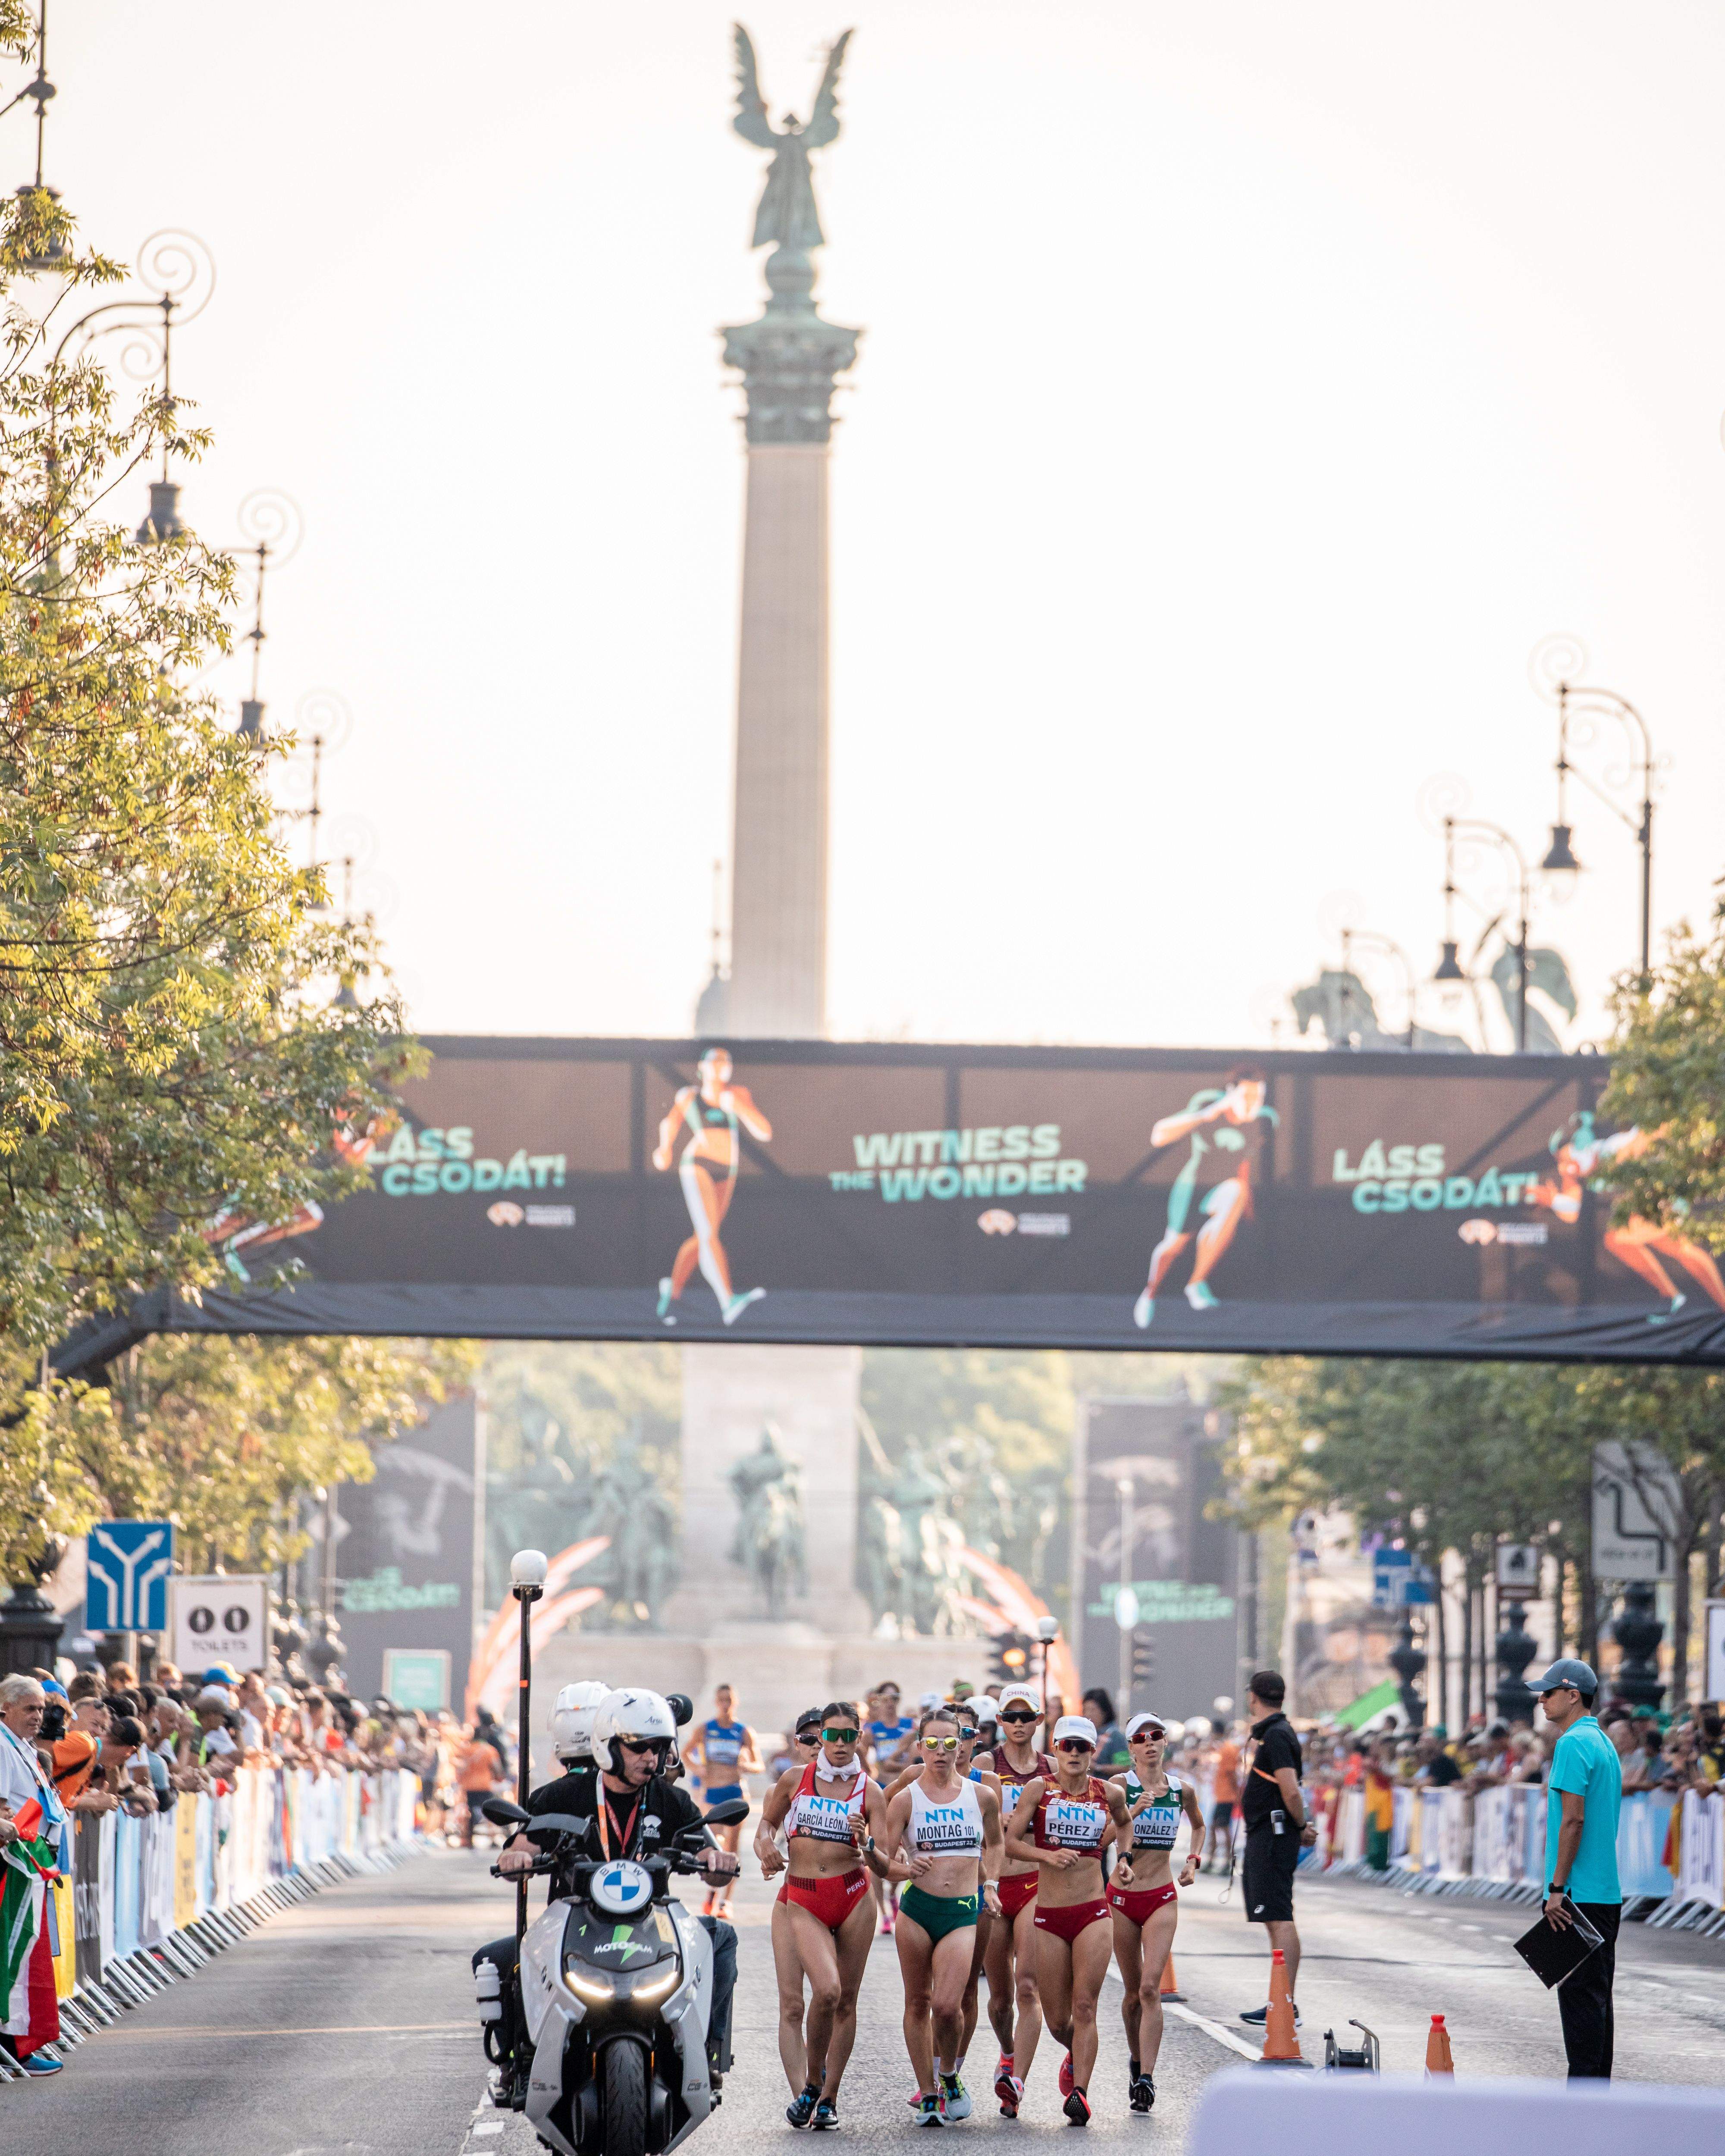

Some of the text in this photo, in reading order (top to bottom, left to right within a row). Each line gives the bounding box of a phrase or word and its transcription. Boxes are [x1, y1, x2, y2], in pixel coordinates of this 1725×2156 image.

[853, 1124, 1061, 1168] WITNESS
[1333, 1139, 1446, 1181] LÁSS
[382, 1148, 567, 1197] CSODÁT!
[829, 1159, 1088, 1203] THE WONDER
[1351, 1166, 1539, 1213] CSODÁT!
[809, 1797, 849, 1816] NTN
[1058, 1806, 1095, 1822] NTN
[1139, 1808, 1173, 1821] NTN
[798, 1813, 822, 1826] GARCÍA
[825, 1817, 844, 1830] LEÓN
[925, 1808, 964, 1824] NTN
[917, 1824, 962, 1840] MONTAG
[965, 1826, 974, 1836] 101
[1049, 1822, 1090, 1836] PÉREZ
[1134, 1823, 1170, 1836] ONZÁLEZ
[599, 1862, 643, 1877] BMW
[594, 1941, 653, 1955] MOTOCAM
